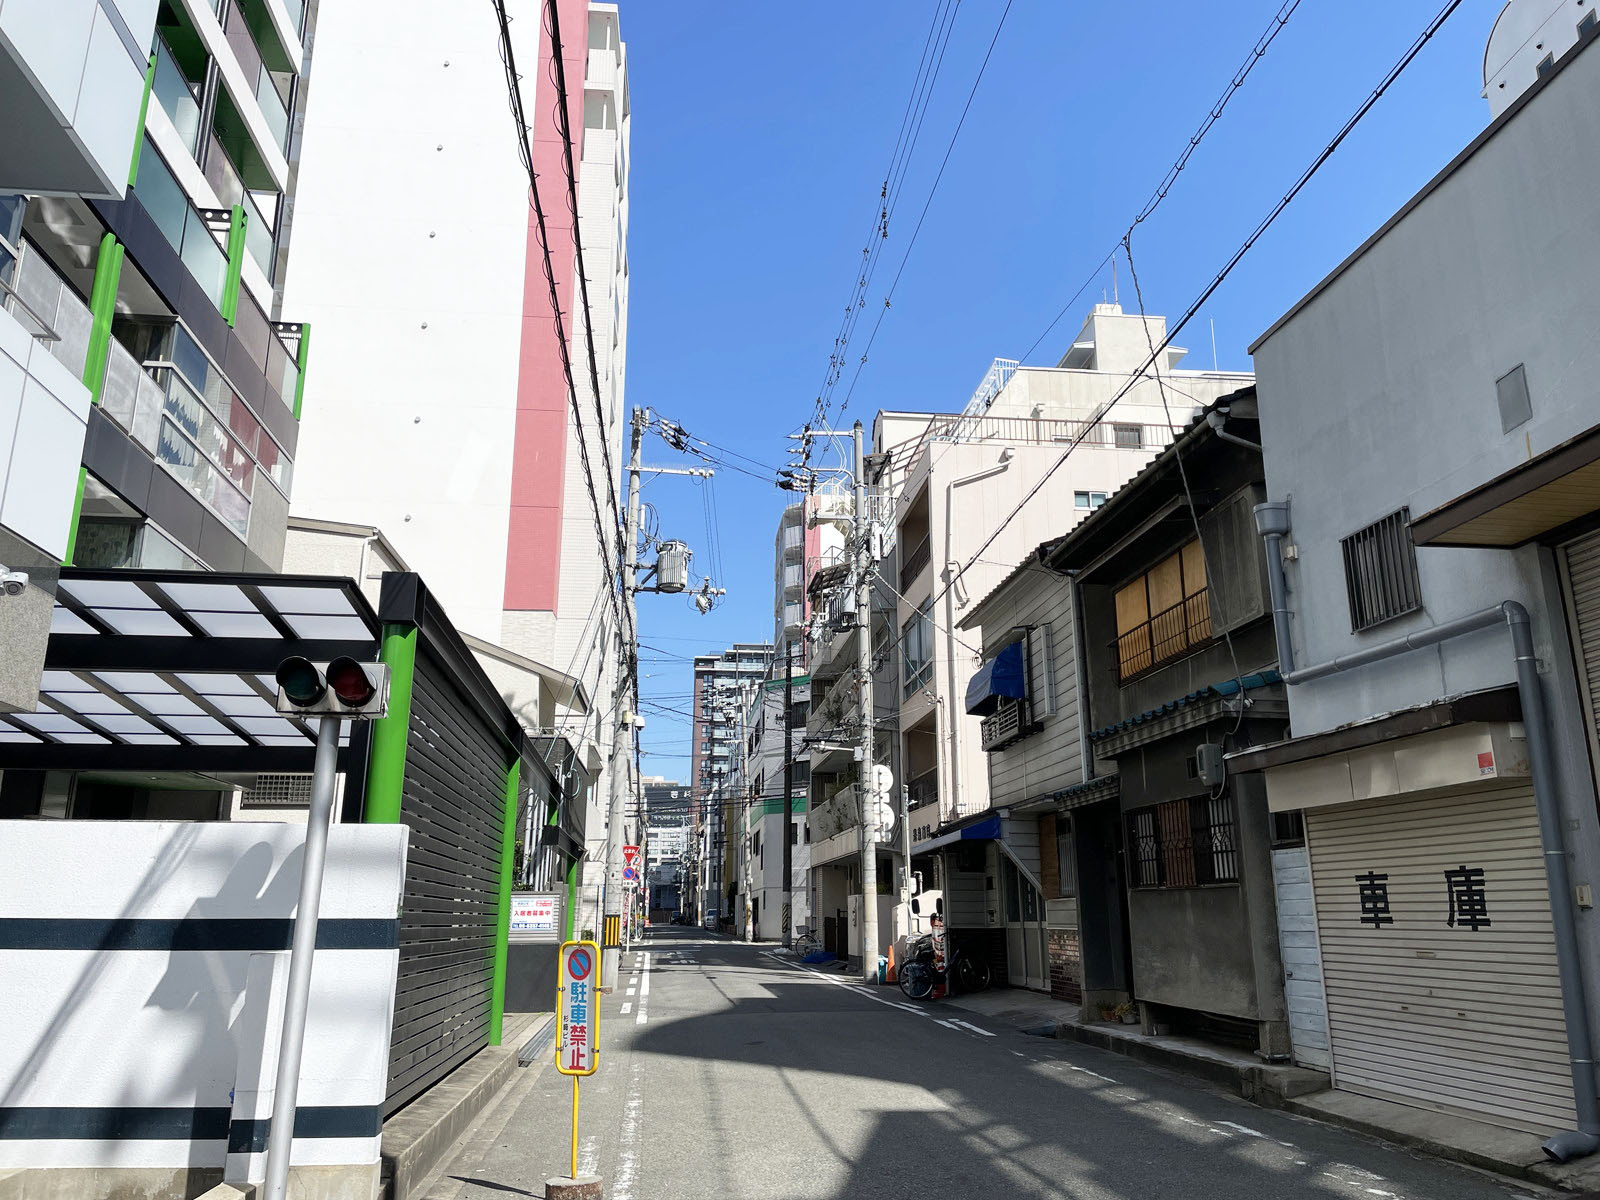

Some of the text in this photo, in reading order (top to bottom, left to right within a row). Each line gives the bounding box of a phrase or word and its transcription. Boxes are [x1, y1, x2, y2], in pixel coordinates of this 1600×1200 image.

[1355, 865, 1491, 932] 車庫
[569, 982, 587, 1070] 駐車禁止
